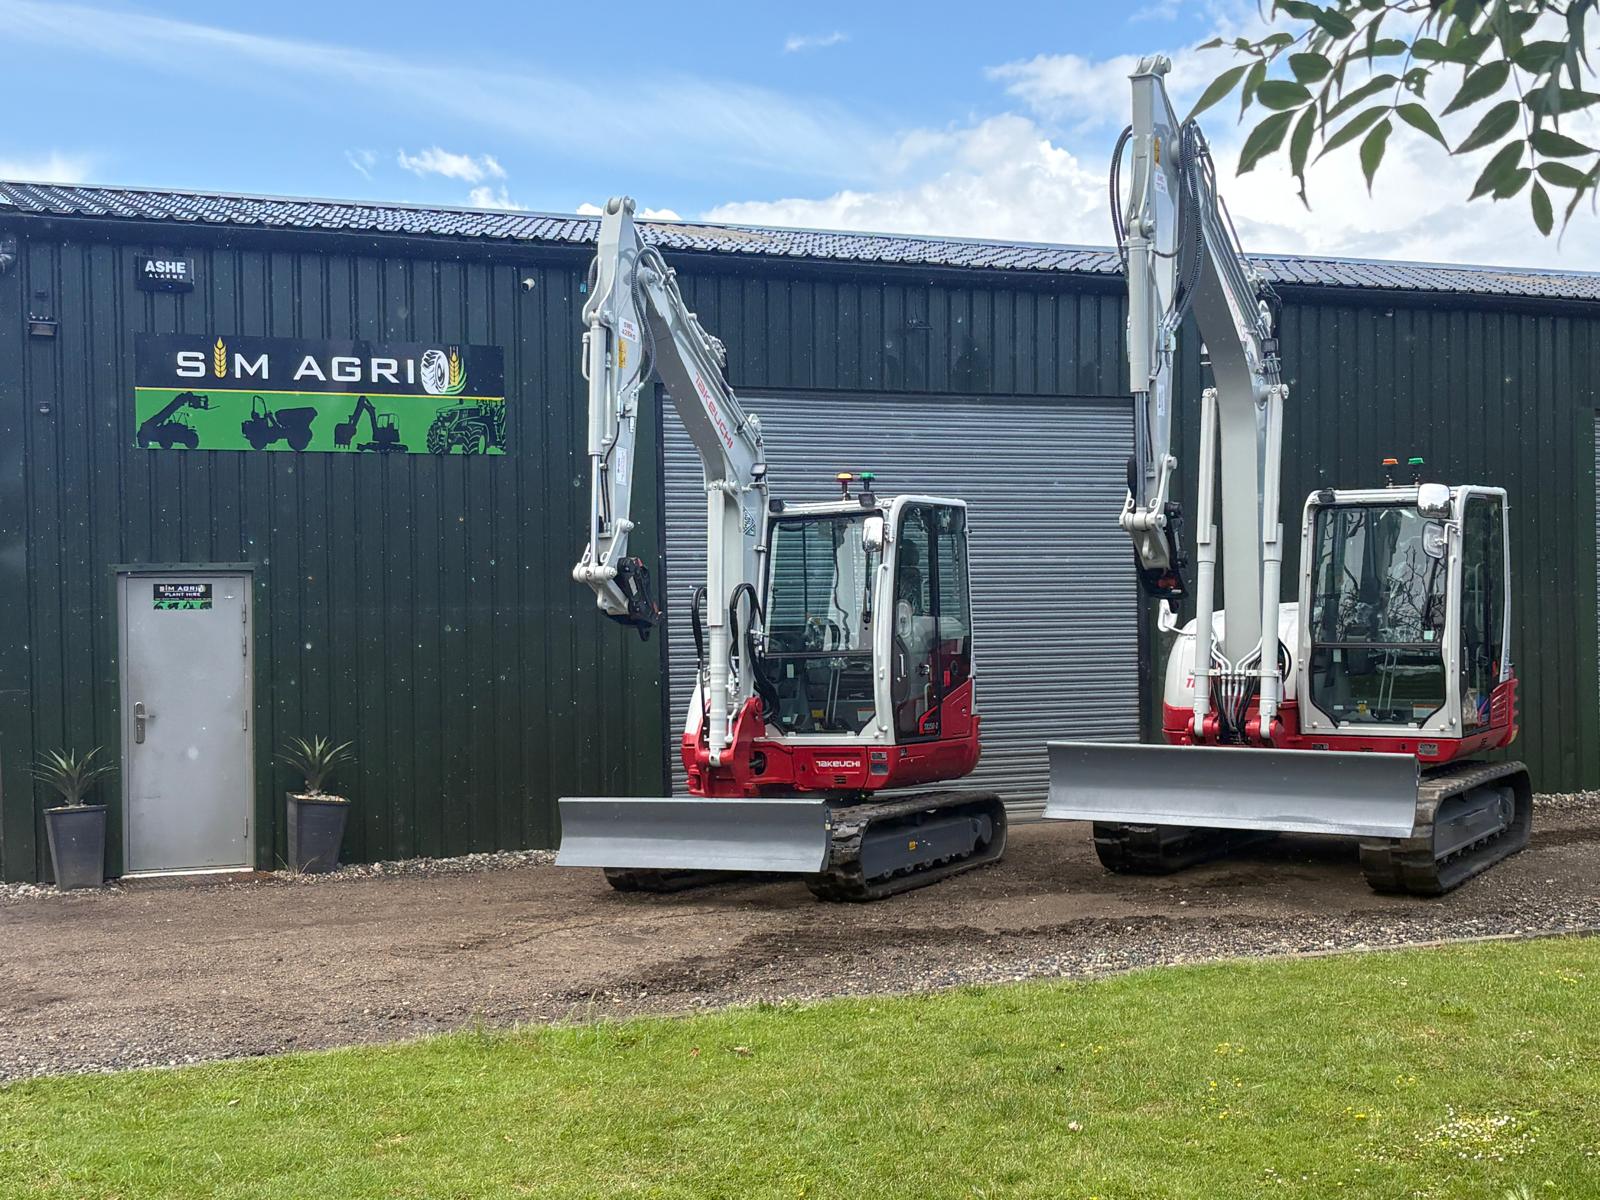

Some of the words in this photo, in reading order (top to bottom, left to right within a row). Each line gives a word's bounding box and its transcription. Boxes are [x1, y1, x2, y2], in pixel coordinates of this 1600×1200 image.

[145, 260, 186, 274] ASHE
[177, 337, 269, 379] SIM
[293, 355, 415, 384] AGRI
[696, 371, 734, 449] TAKEUCHI
[816, 760, 861, 768] TAKEUCHI
